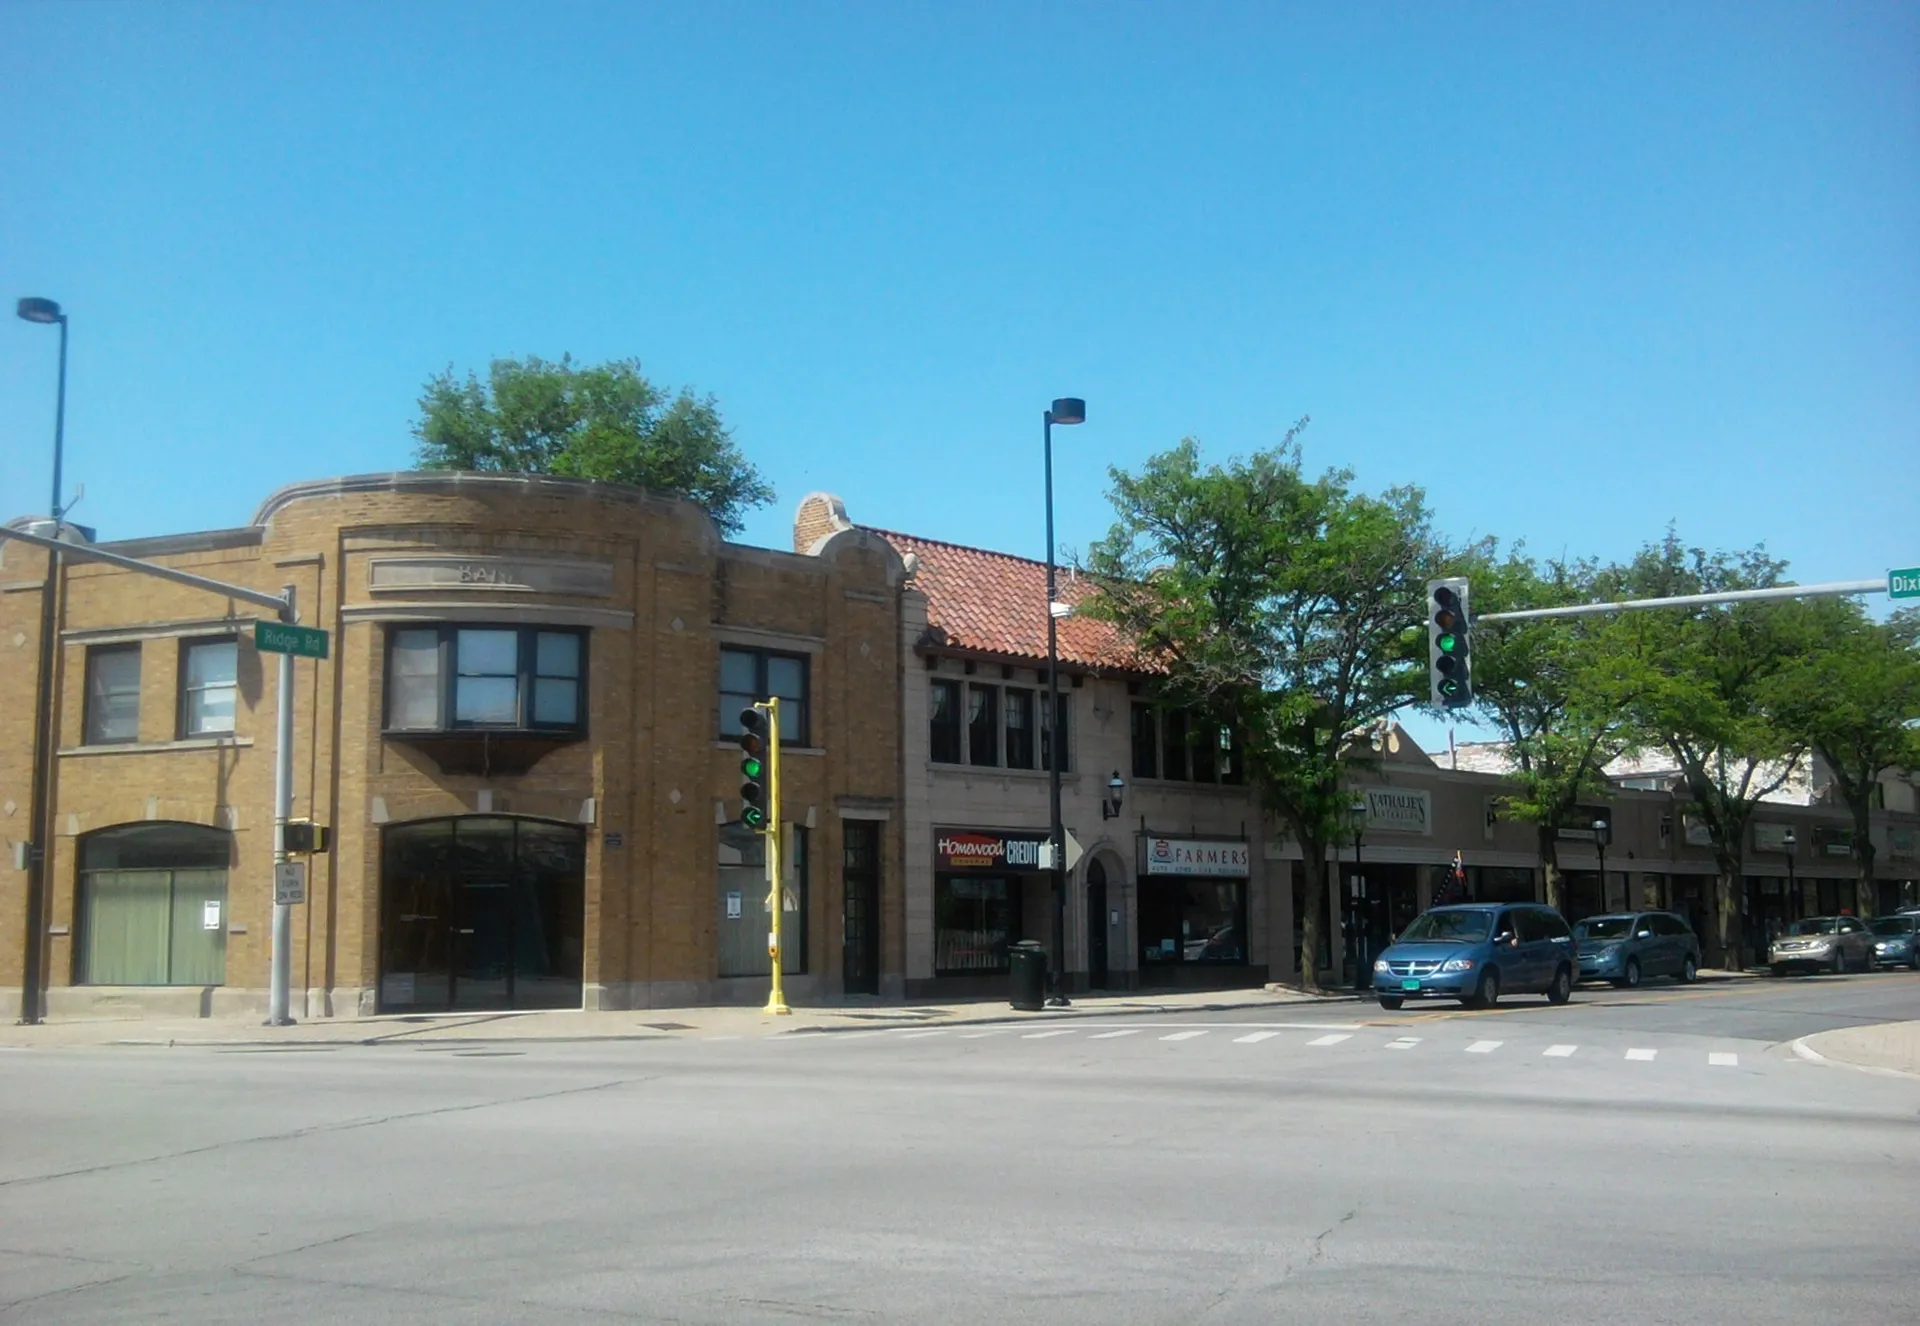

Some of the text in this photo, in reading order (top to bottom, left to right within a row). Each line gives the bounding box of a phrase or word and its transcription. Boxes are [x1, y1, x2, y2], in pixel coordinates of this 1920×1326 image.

[263, 628, 320, 652] Ridge Rd
[938, 838, 1005, 857] Homewood
[1006, 840, 1039, 864] CREDIT
[1175, 848, 1247, 865] FARMERS
